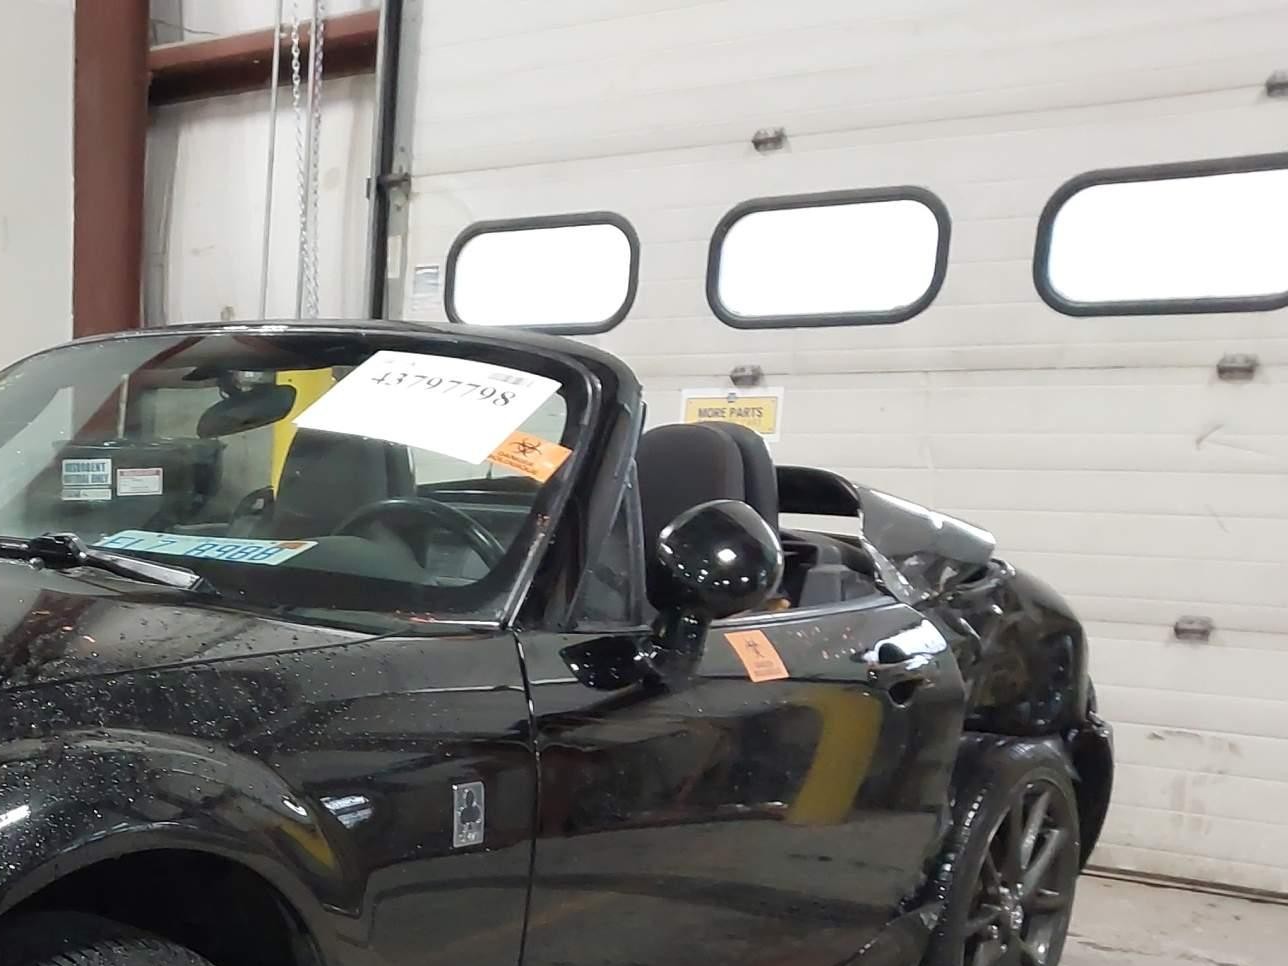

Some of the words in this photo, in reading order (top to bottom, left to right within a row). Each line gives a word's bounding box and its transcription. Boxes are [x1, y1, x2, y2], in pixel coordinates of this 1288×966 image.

[371, 371, 516, 407] 43797798
[698, 407, 727, 418] MORE
[729, 406, 764, 418] PARTS
